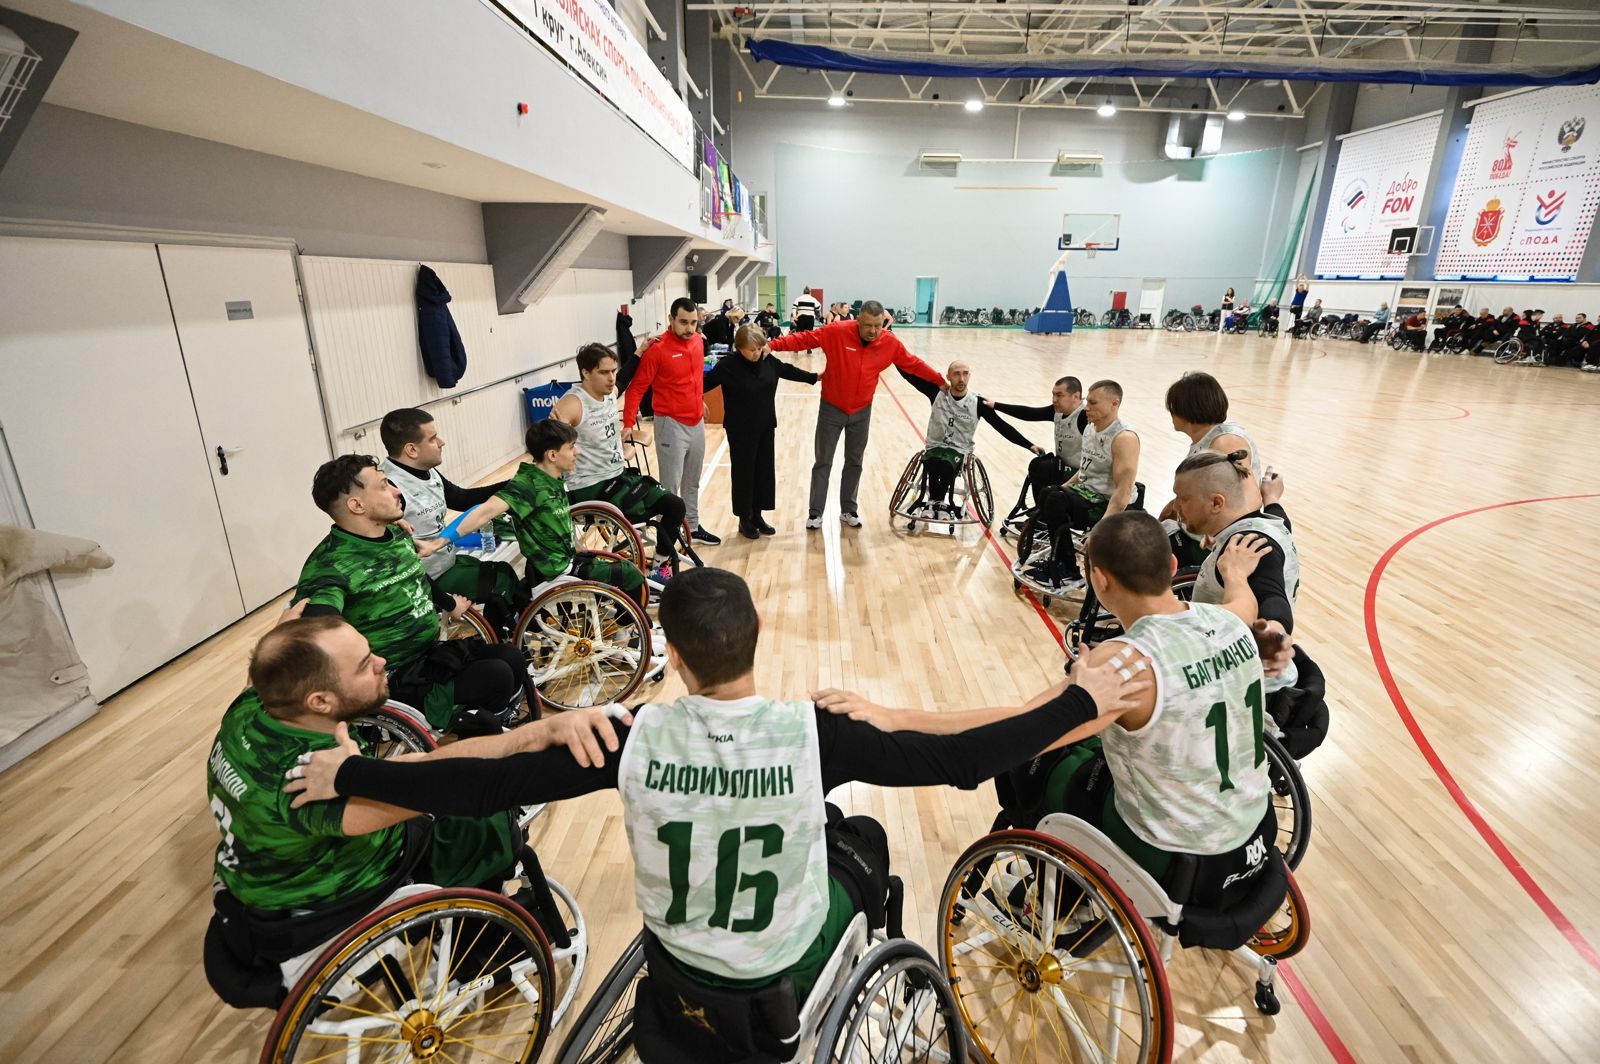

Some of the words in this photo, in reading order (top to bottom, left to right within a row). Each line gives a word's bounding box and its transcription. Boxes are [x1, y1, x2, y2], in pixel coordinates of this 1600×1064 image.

[541, 6, 565, 44] круг
[1386, 171, 1418, 197] Добро
[1381, 195, 1415, 215] FON
[604, 422, 616, 440] 23
[948, 417, 955, 428] 8
[1081, 456, 1093, 471] 27
[1205, 678, 1266, 793] 11
[644, 759, 795, 799] САФИУЛЛИН
[657, 821, 785, 933] 16
